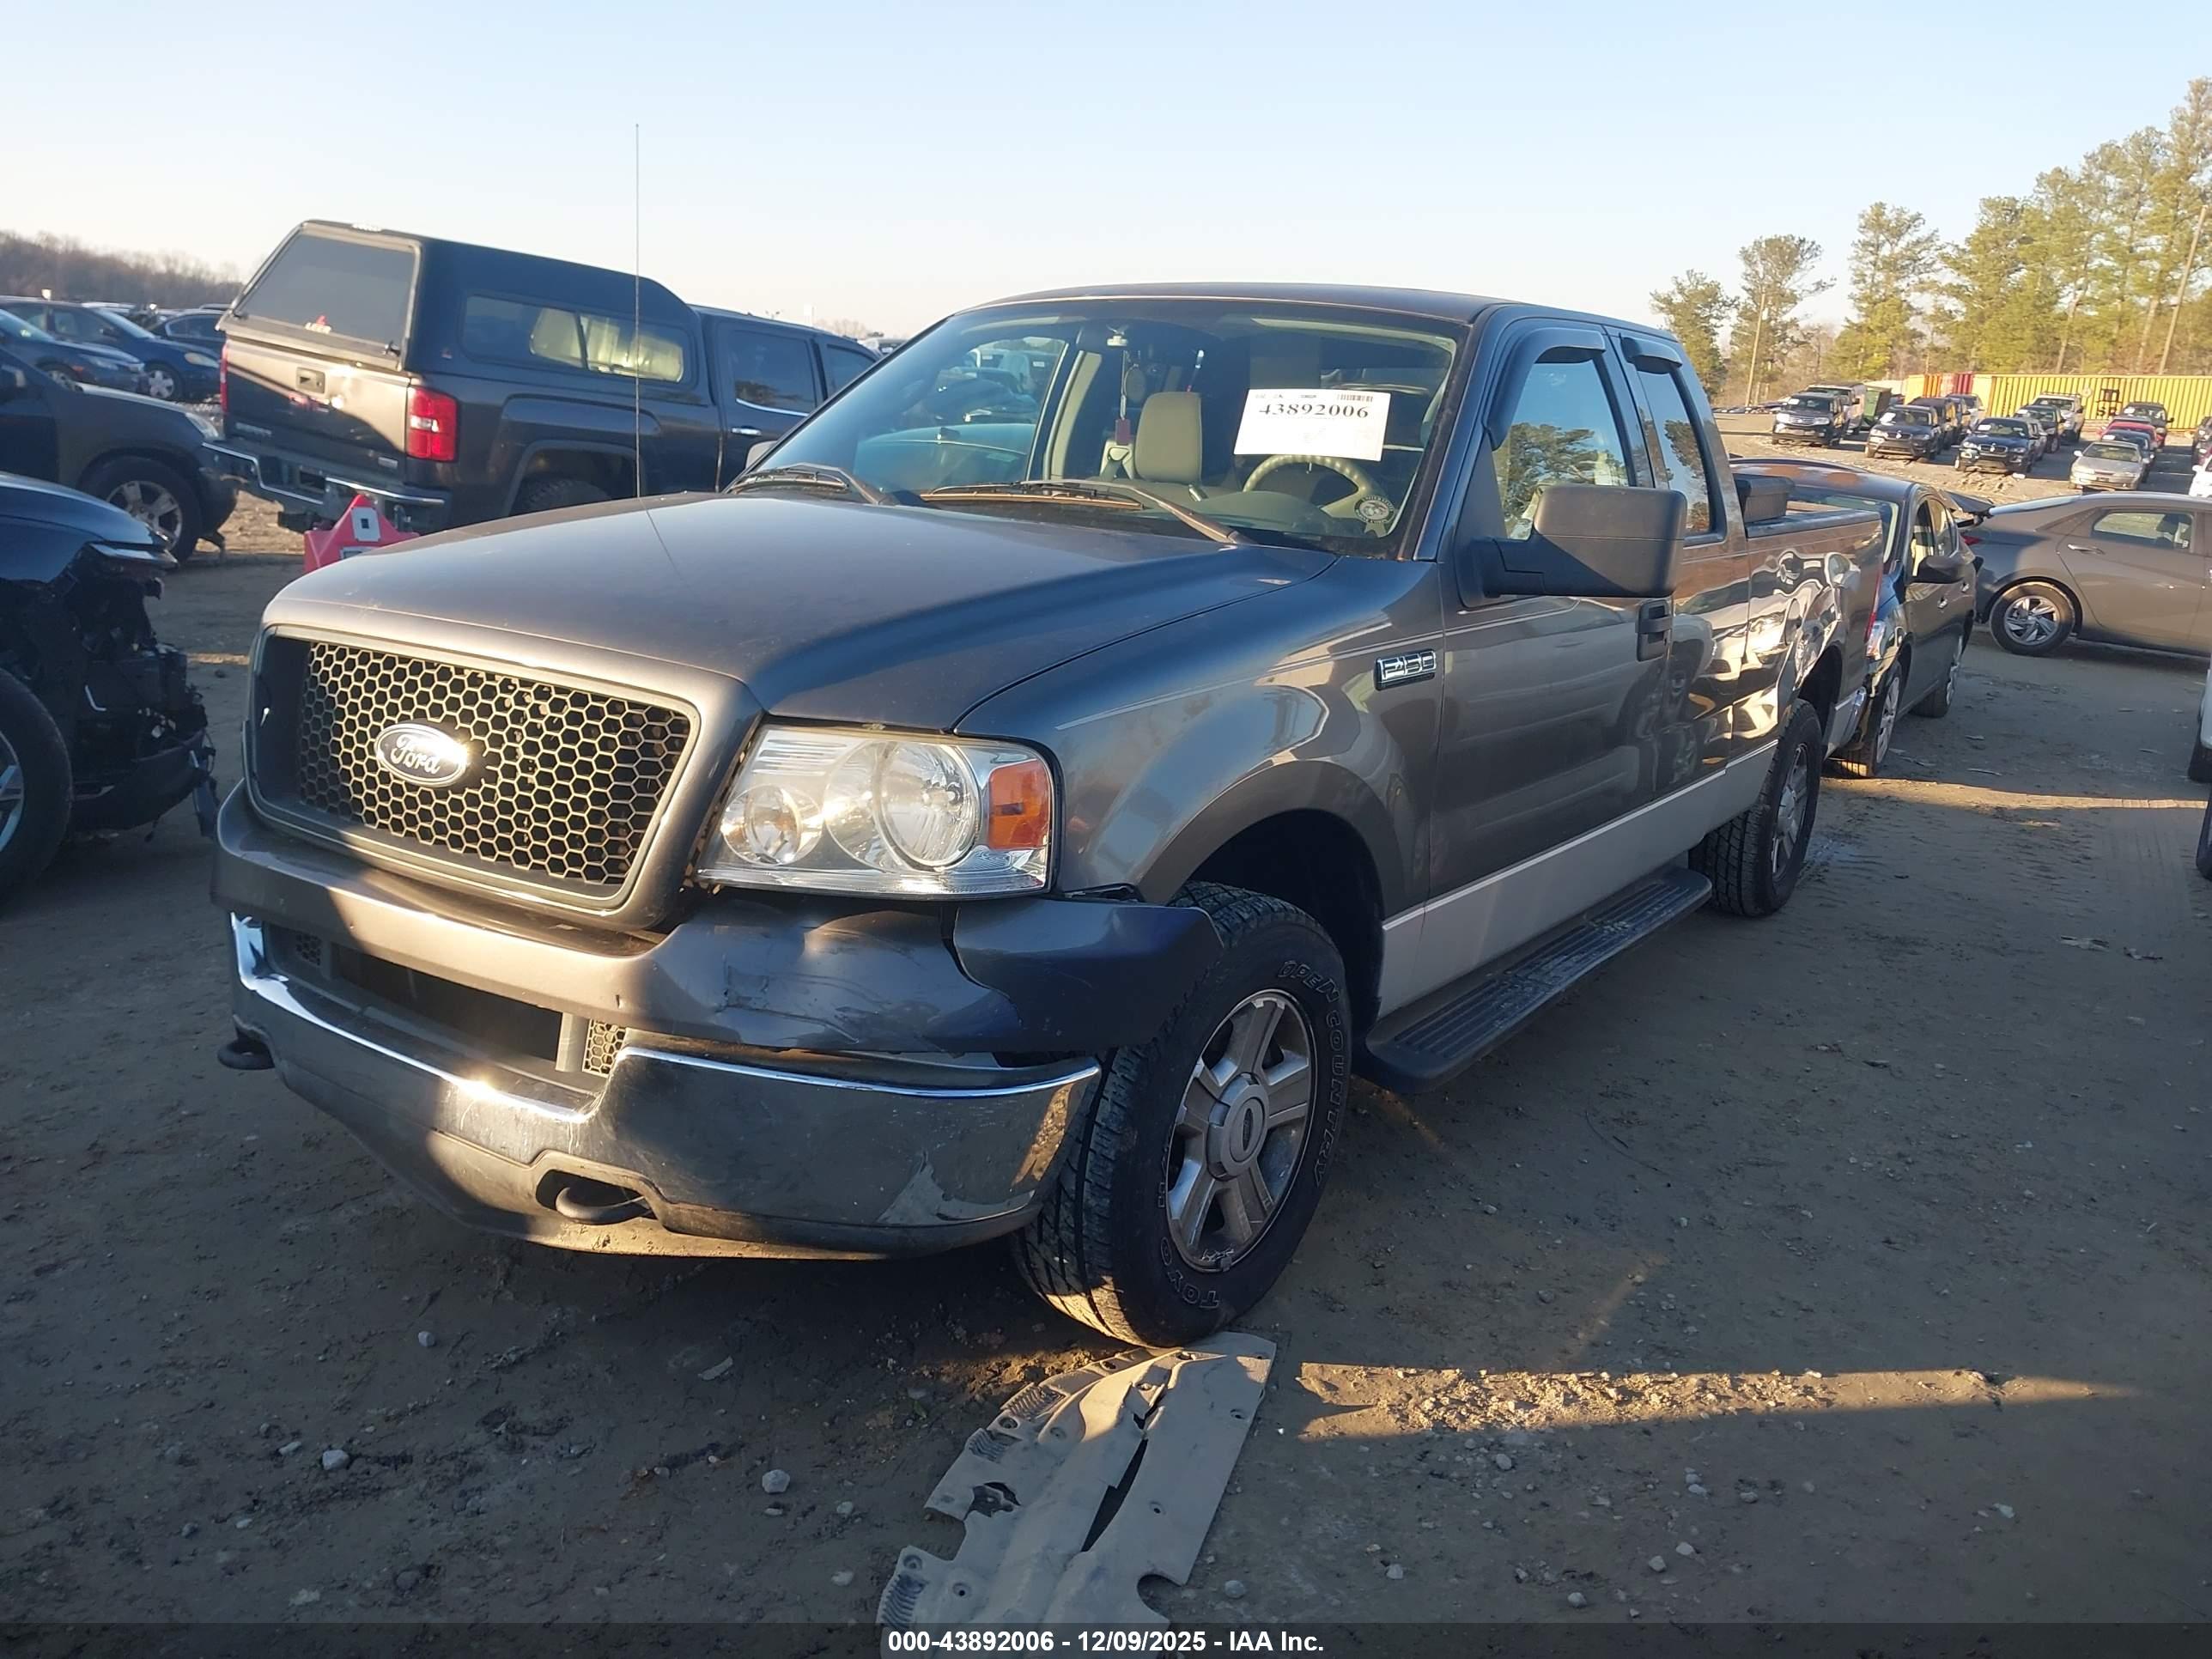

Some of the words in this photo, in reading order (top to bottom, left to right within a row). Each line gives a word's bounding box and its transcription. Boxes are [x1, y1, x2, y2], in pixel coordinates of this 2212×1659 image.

[1258, 403, 1370, 419] 43892006
[390, 733, 441, 775] Ford
[1277, 959, 1341, 1004] OPEN
[1313, 1009, 1349, 1188] COUNTRY
[1159, 1236, 1221, 1310] TOYO
